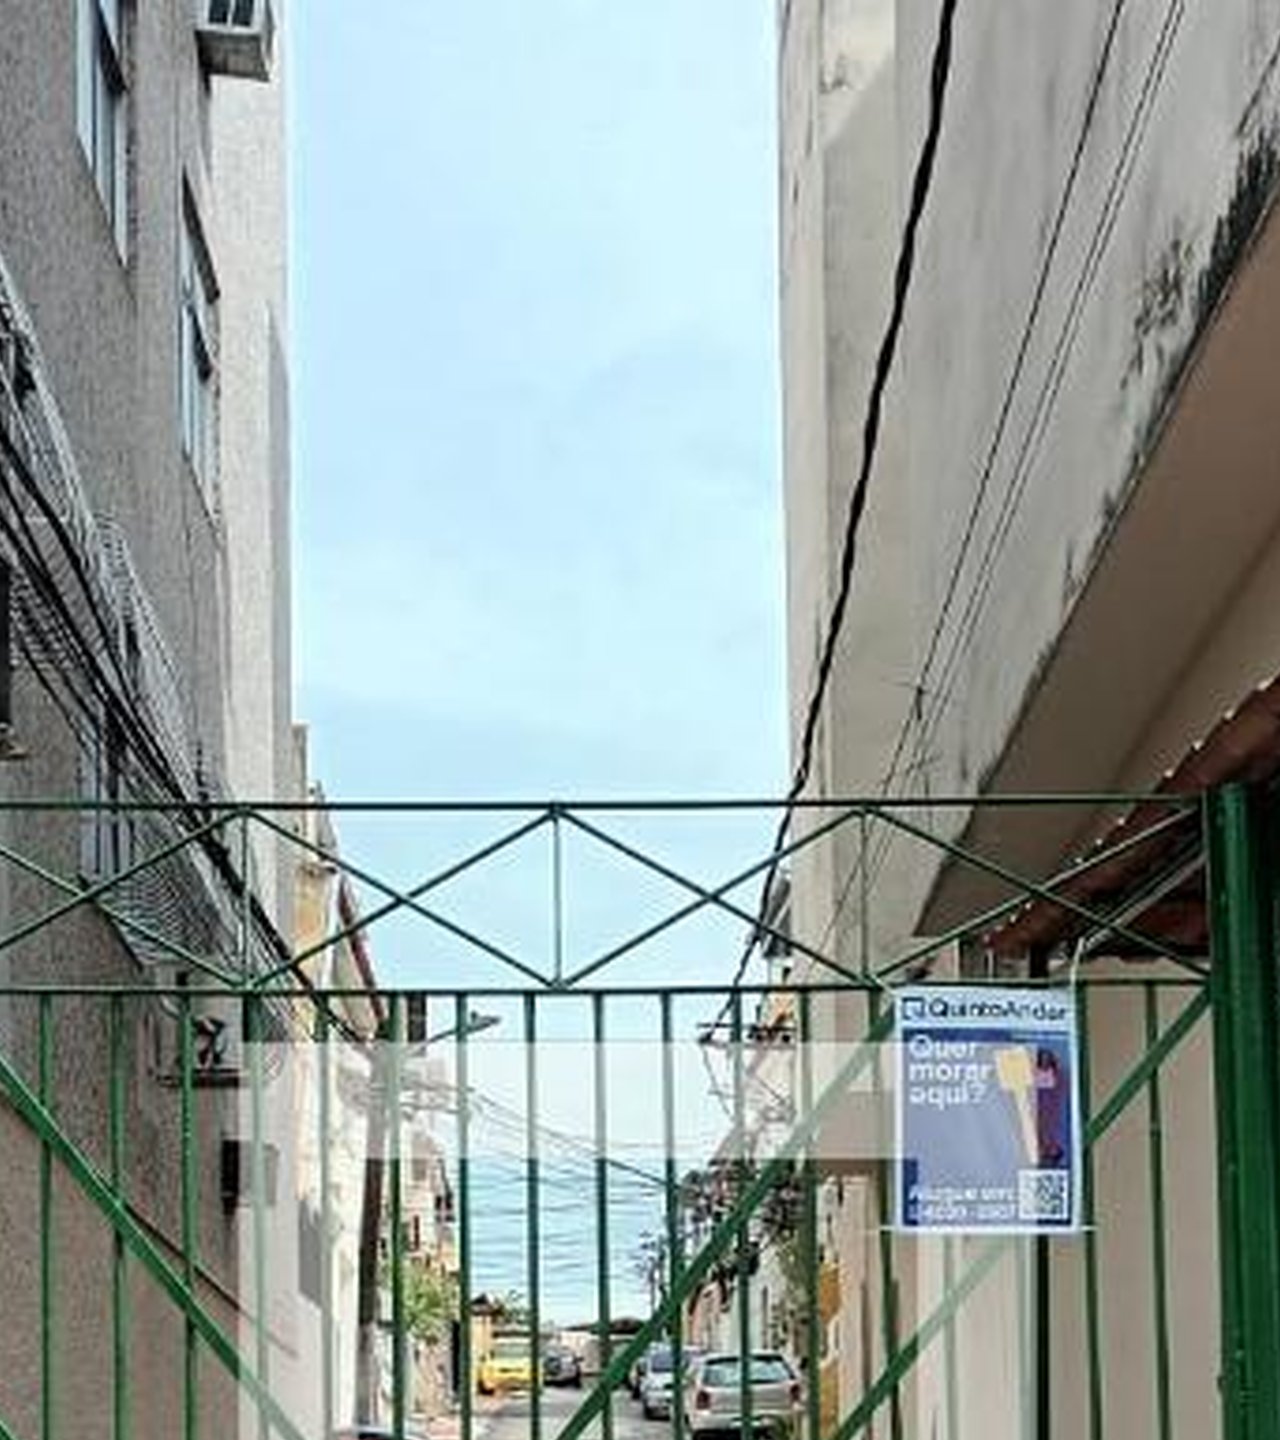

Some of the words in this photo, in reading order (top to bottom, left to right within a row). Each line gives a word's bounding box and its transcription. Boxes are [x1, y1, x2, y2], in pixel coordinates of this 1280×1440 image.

[908, 1034, 978, 1059] Quer
[908, 1063, 993, 1081] morar
[908, 1080, 987, 1110] aqui?
